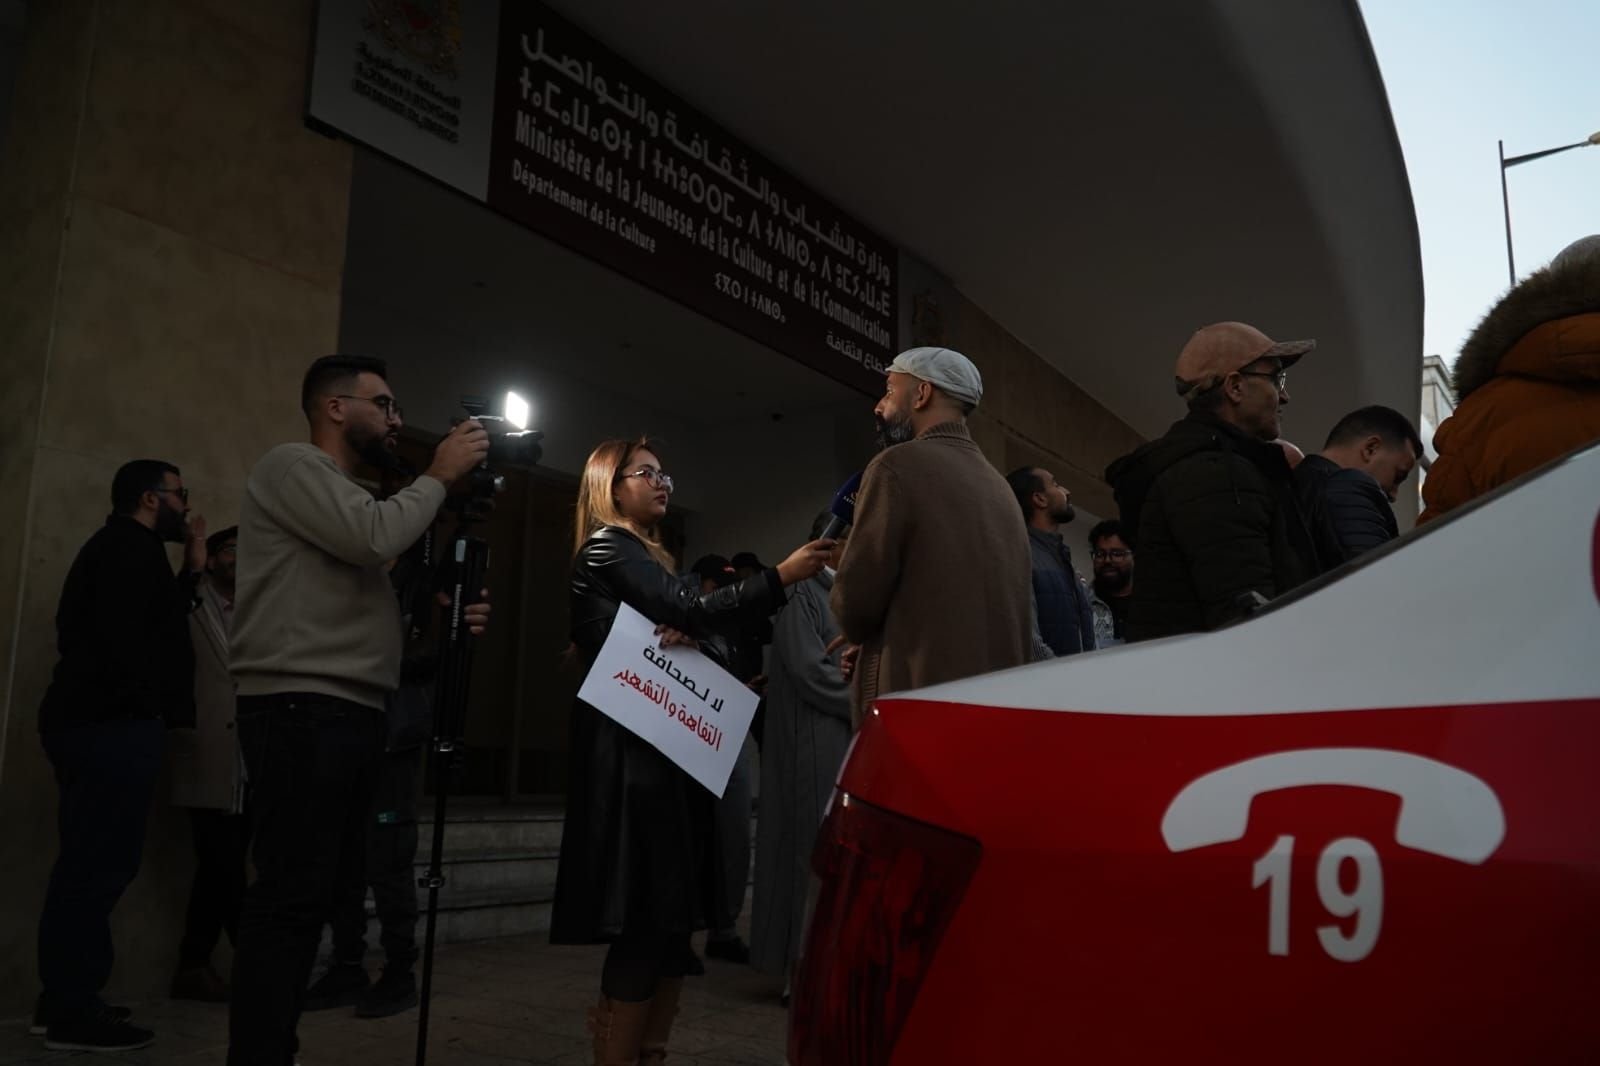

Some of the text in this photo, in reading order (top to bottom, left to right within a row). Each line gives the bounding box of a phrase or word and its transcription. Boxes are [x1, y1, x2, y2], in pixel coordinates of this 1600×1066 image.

[519, 66, 633, 160] ⵜⴰⵎⴰⵡⴰⵙⵜ
[520, 25, 659, 138] والتواصل
[512, 157, 656, 254] Département de la Culture
[662, 109, 780, 216] والثقافة
[514, 109, 891, 350] Ministère de la Jeunesse, de la Culture et de la Communication
[782, 197, 855, 261] الشباب
[857, 240, 891, 287] وزارة
[613, 670, 723, 752] التفاهة والتشهير
[710, 697, 724, 712] لا
[1250, 833, 1385, 965] 19
